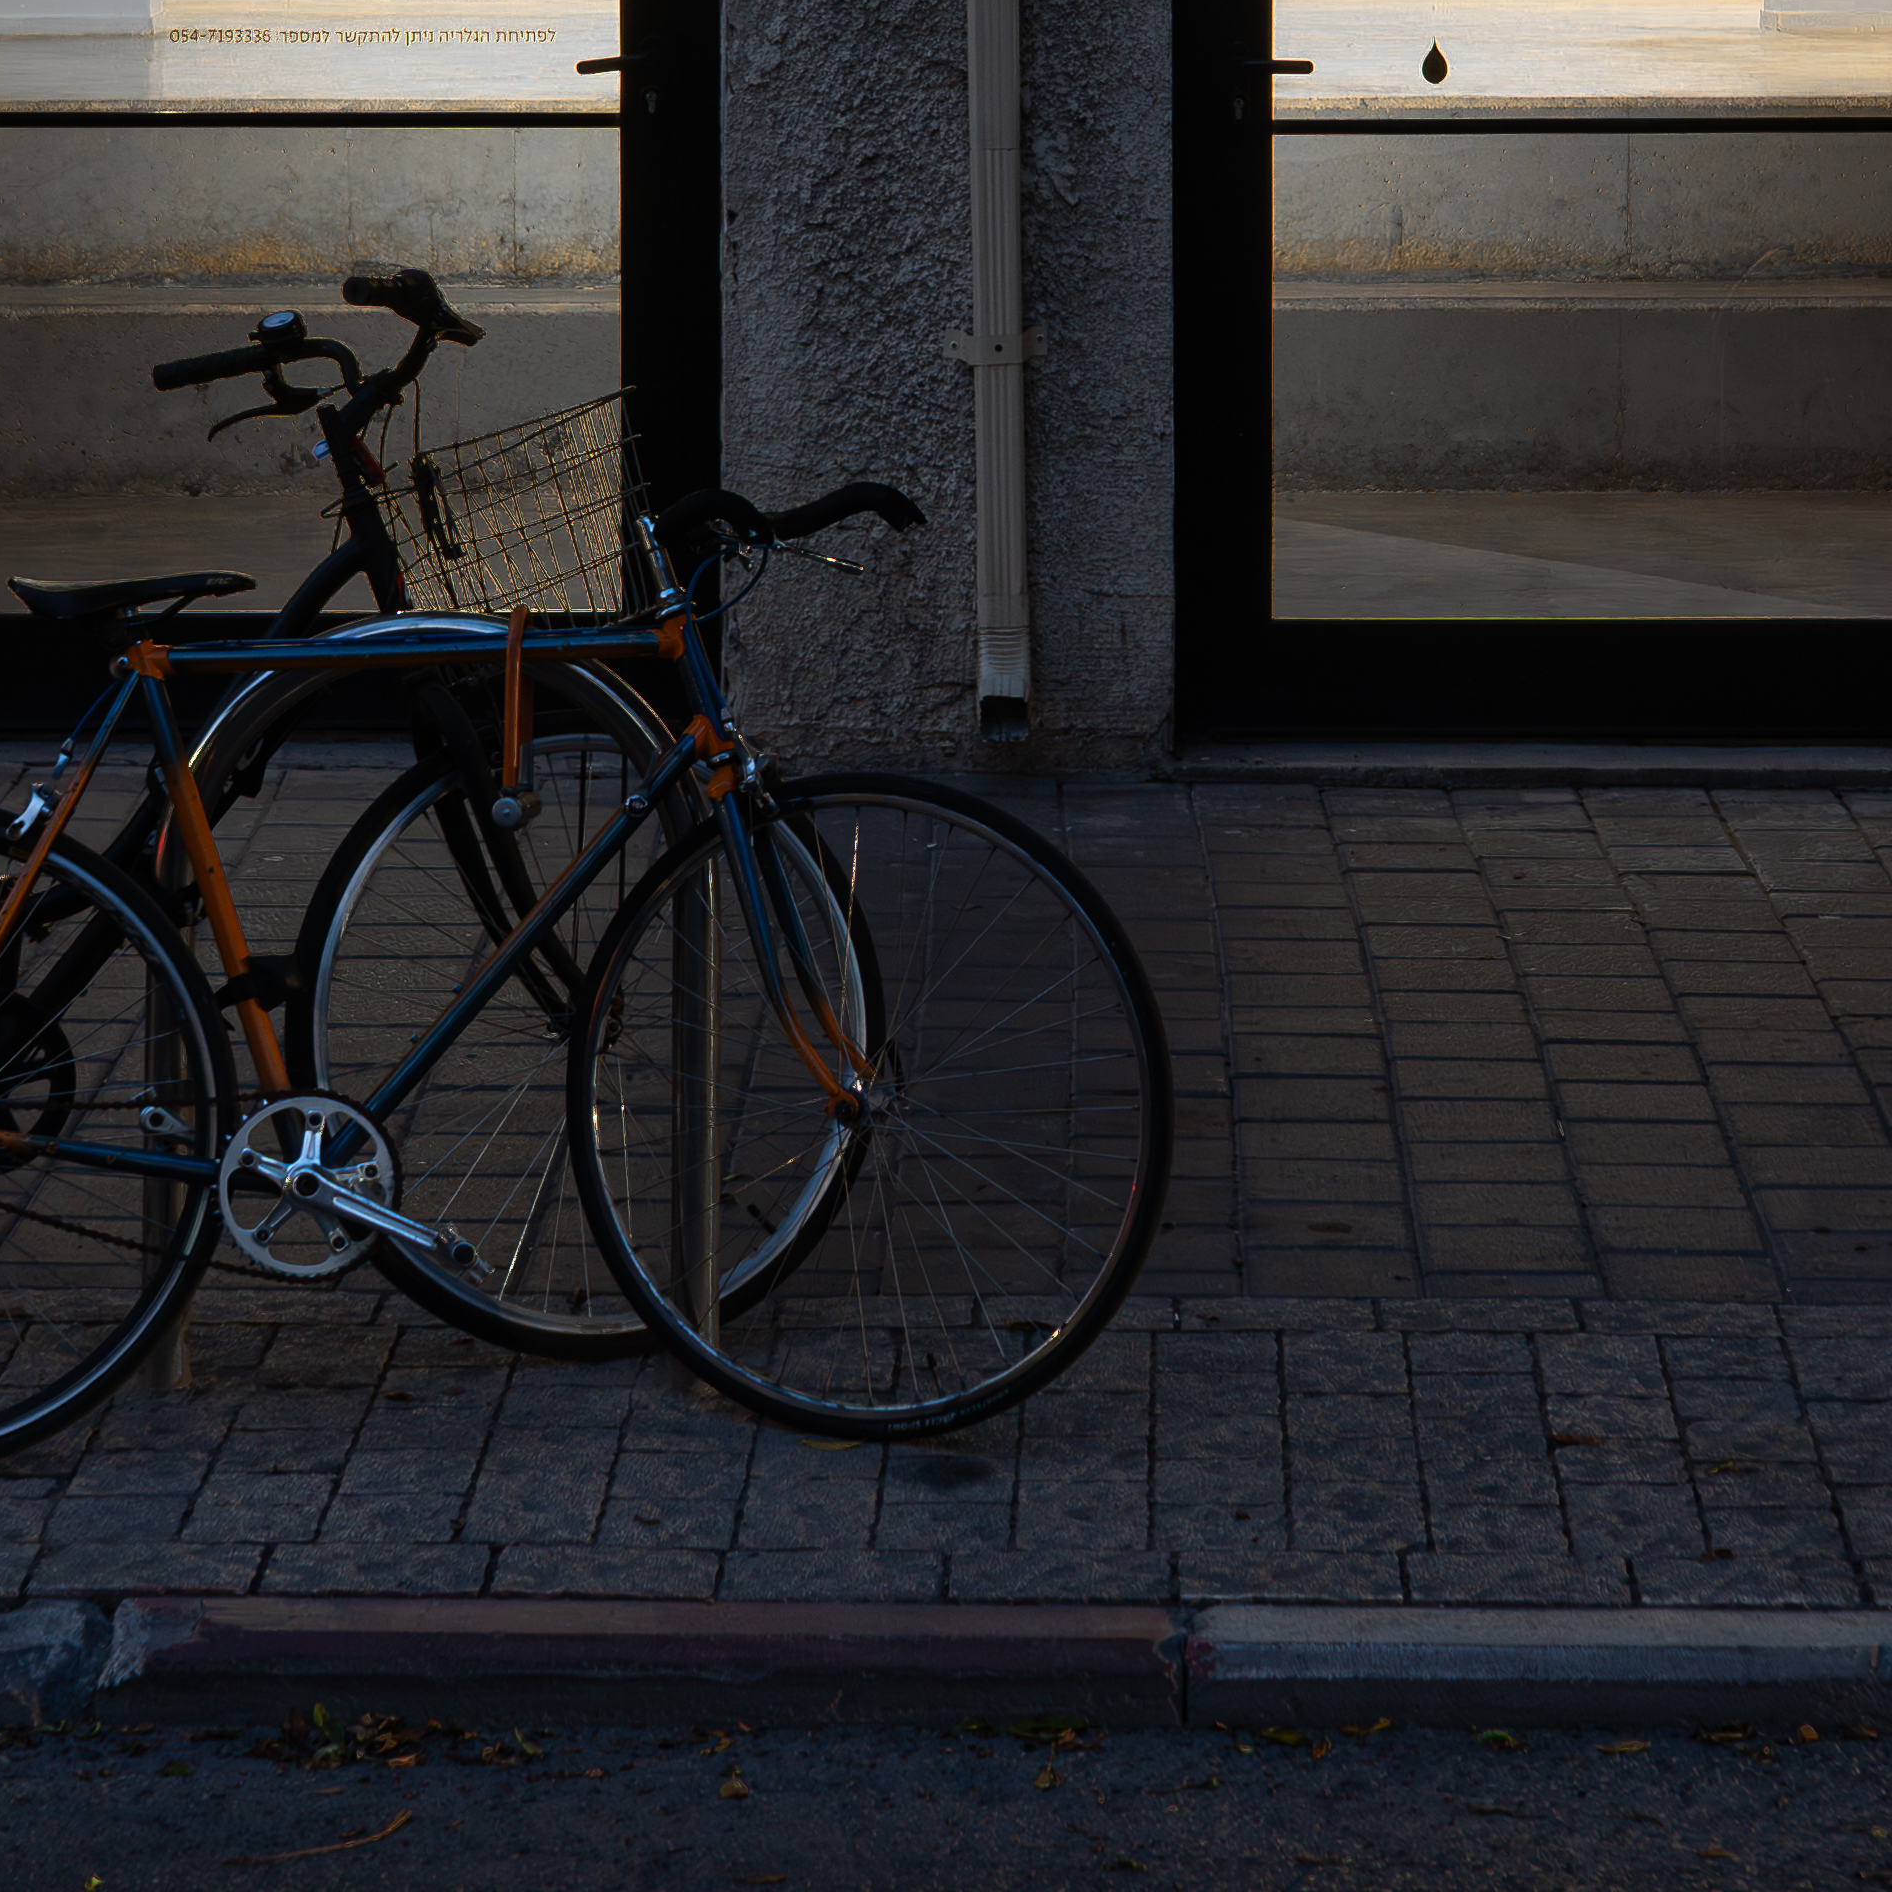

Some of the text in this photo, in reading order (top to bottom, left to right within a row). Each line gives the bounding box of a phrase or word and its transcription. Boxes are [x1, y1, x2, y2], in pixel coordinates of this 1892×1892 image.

[168, 28, 557, 47] לפתיחת הגלריה ניתן להתקשר למספר: 054-7193336
